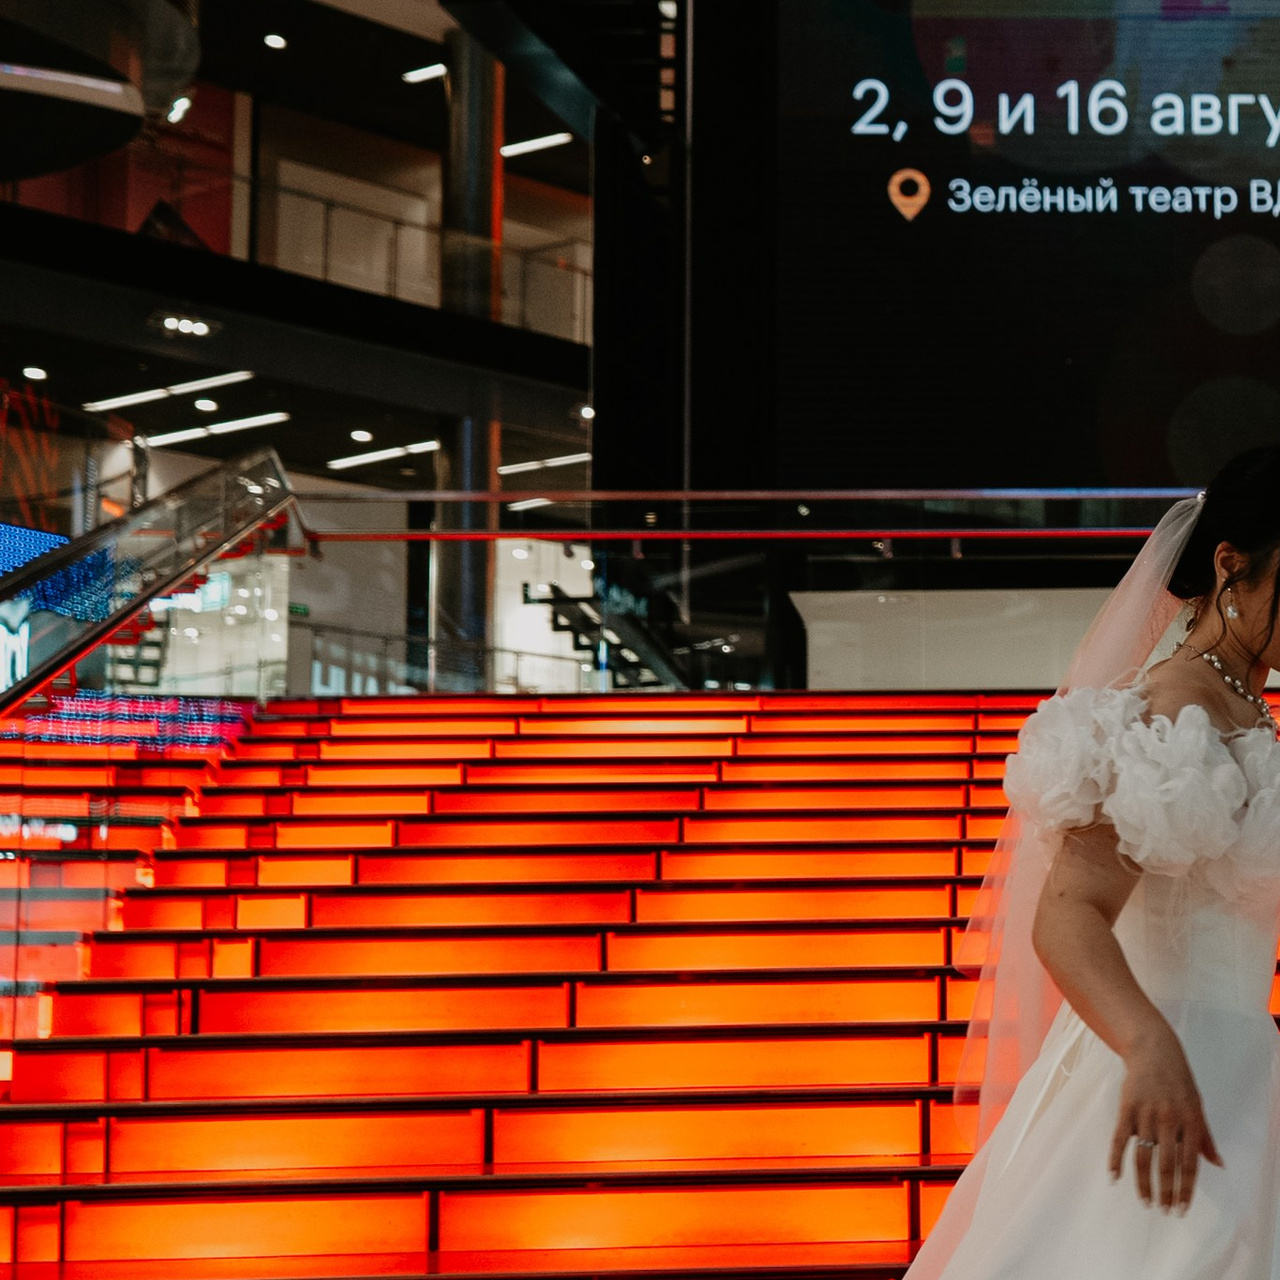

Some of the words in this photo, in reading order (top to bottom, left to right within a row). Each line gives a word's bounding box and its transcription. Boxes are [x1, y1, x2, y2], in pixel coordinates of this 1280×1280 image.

[852, 79, 908, 142] 2,
[933, 79, 974, 136] 9
[1000, 93, 1035, 135] и
[1056, 79, 1128, 136] 16
[947, 178, 1118, 213] Зелёный
[1129, 184, 1238, 219] театр
